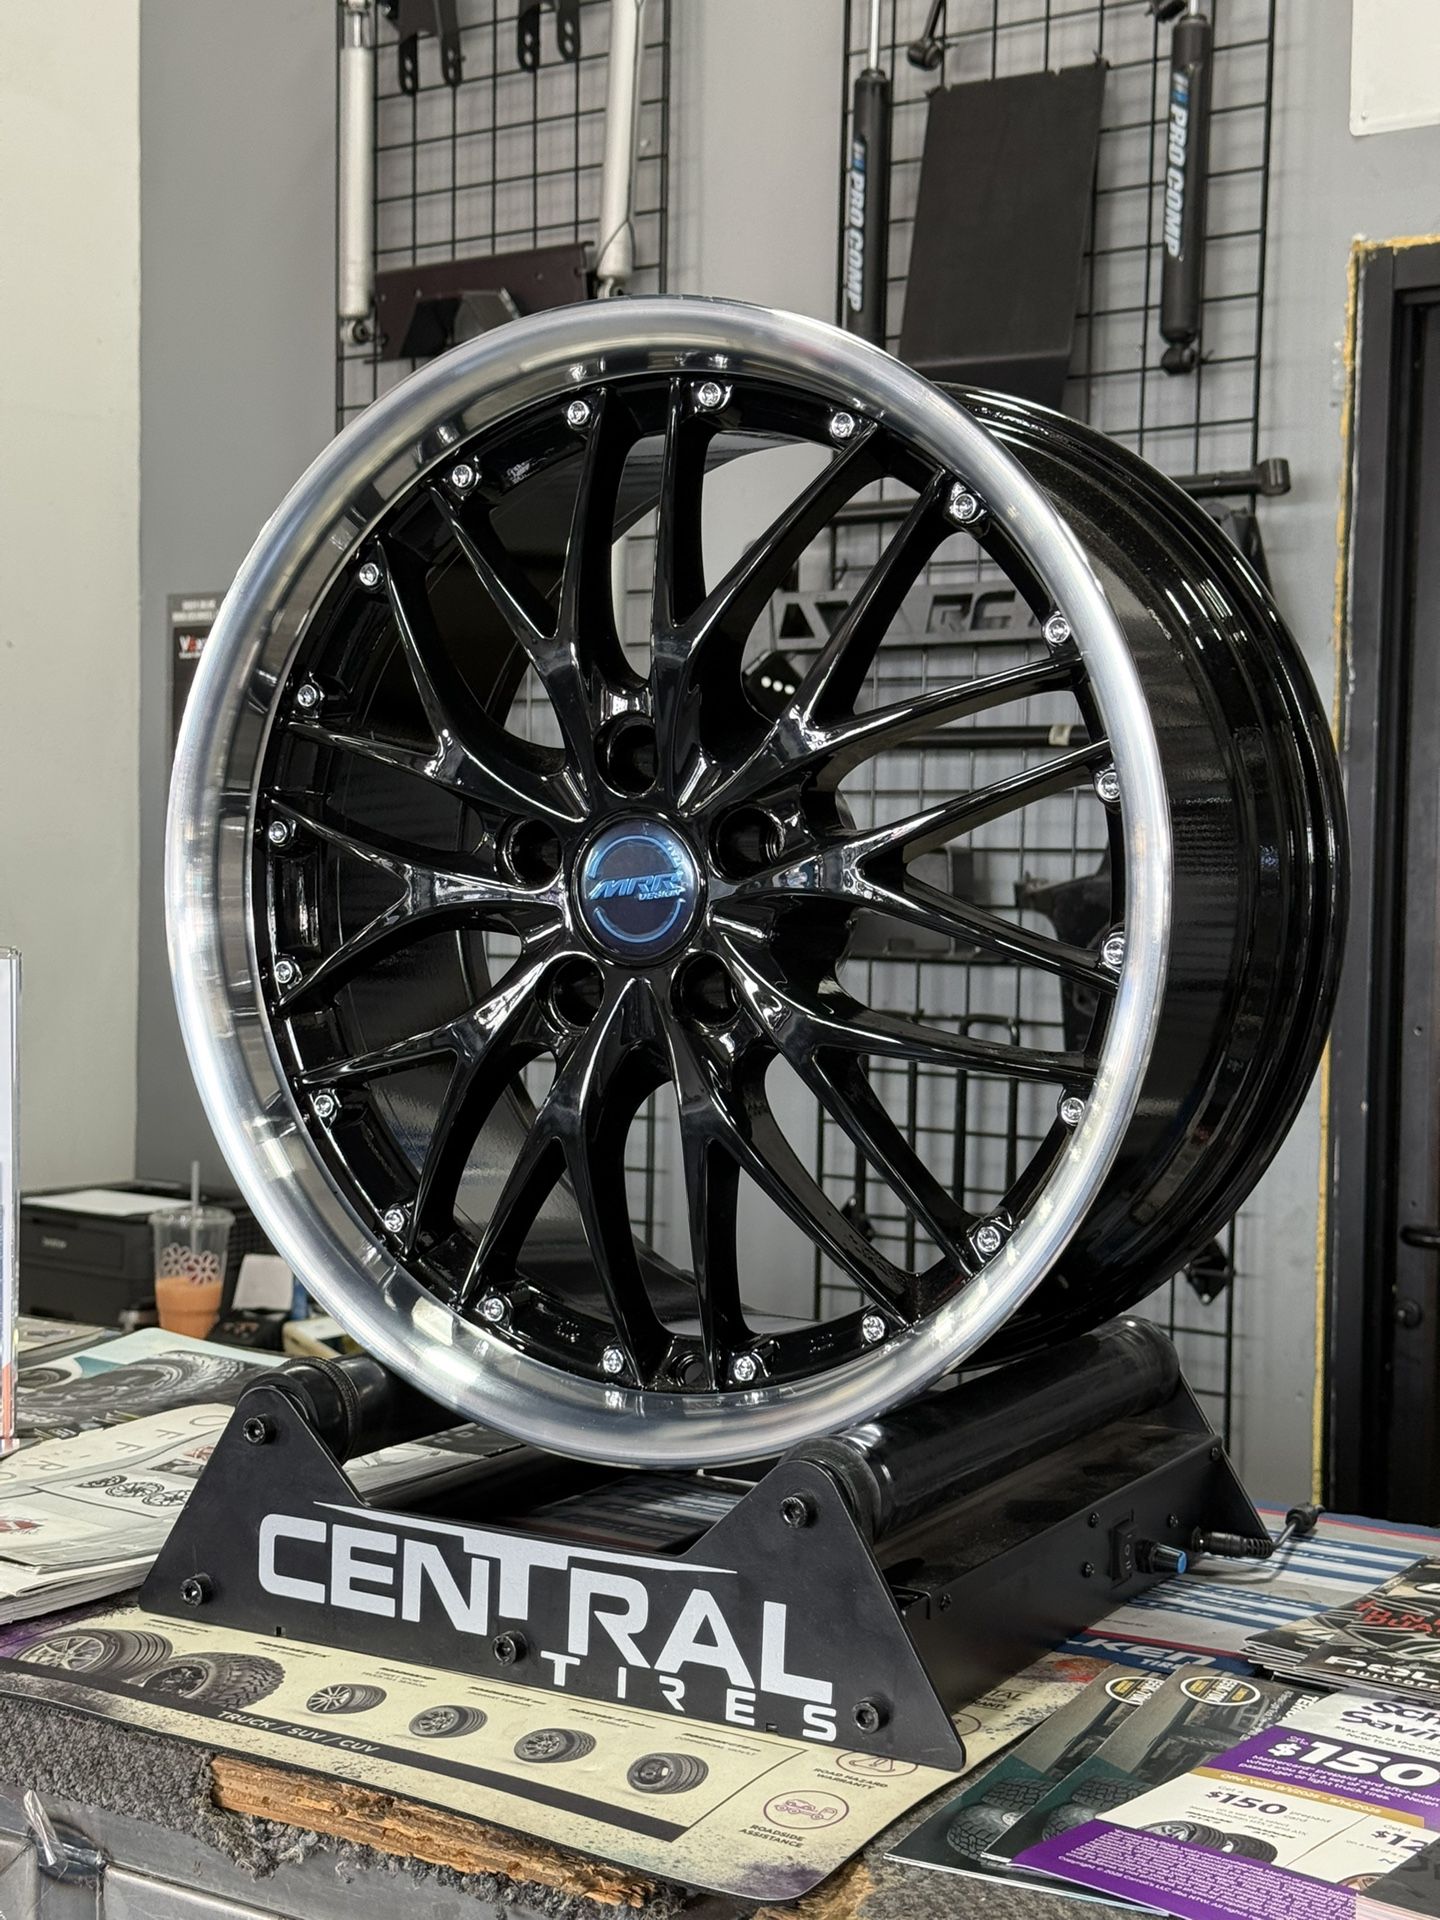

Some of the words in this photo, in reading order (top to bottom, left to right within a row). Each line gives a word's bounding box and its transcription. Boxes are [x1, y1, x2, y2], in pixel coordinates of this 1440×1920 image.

[1169, 104, 1188, 166] PRO
[848, 171, 865, 228] PRO
[1164, 167, 1184, 257] COMP
[847, 229, 863, 311] COMP
[258, 1501, 833, 1704] CENTRAL
[540, 1650, 837, 1742] TIRES
[217, 1709, 278, 1730] TRUCK
[287, 1727, 327, 1744] SUV
[339, 1738, 380, 1754] CUV
[813, 1768, 844, 1778] ROAD
[845, 1774, 888, 1788] HAZARD
[816, 1773, 876, 1789] WARRANTY
[1238, 1763, 1293, 1777] passenger
[1334, 1783, 1363, 1794] truck
[1267, 1741, 1440, 1786] $150
[1315, 1768, 1358, 1781] prepaid
[1359, 1779, 1384, 1788] card
[1384, 1785, 1411, 1794] after
[1205, 1791, 1288, 1814] $150
[739, 1828, 804, 1848] ASSISTANCE
[750, 1824, 807, 1842] ROADSIDE
